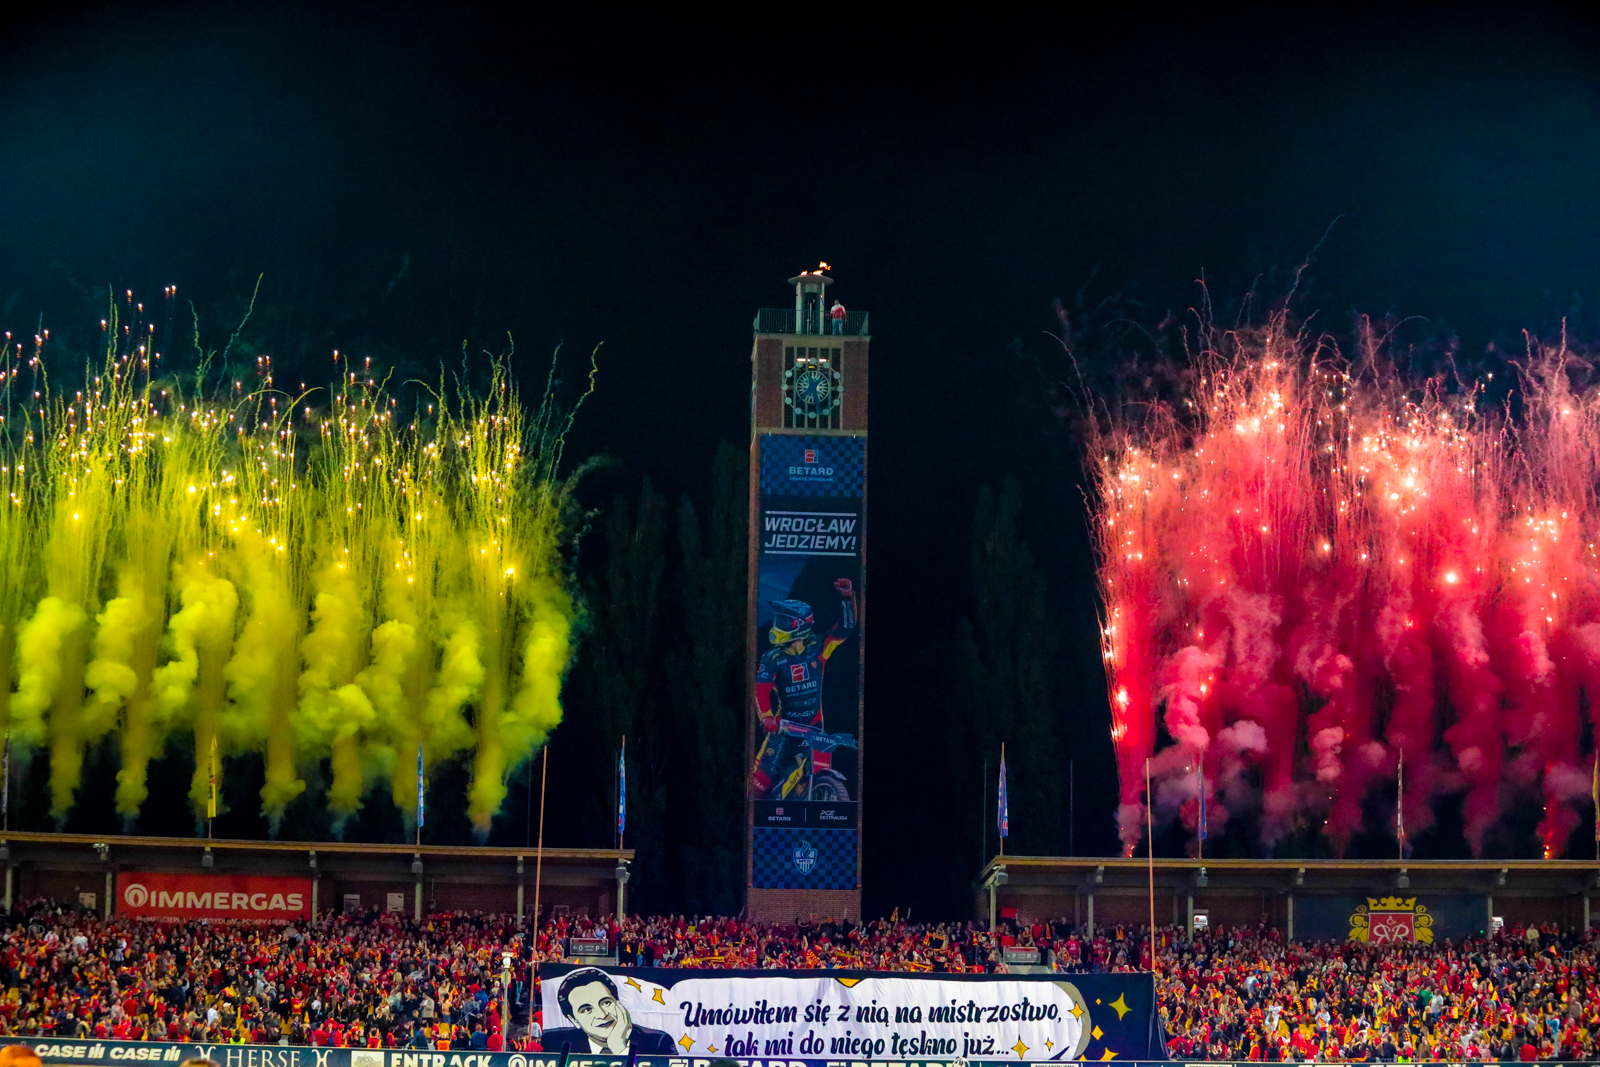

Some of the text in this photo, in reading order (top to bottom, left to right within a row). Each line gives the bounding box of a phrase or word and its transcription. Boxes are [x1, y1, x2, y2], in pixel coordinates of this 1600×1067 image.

[789, 466, 834, 476] BETARD
[764, 517, 857, 534] WROCŁAW
[764, 534, 857, 550] JEDZIEMY!
[785, 680, 817, 693] BETARD
[150, 890, 304, 911] IMMERGAS
[679, 997, 1062, 1028] Umówiłem się z nią na mistrzostwo,
[35, 1044, 87, 1058] CASE
[109, 1047, 162, 1061] CASE
[724, 1030, 1010, 1059] tak mi do niego tęskno już...
[226, 1048, 301, 1067] HERSE
[391, 1052, 492, 1067] ENTRACK
